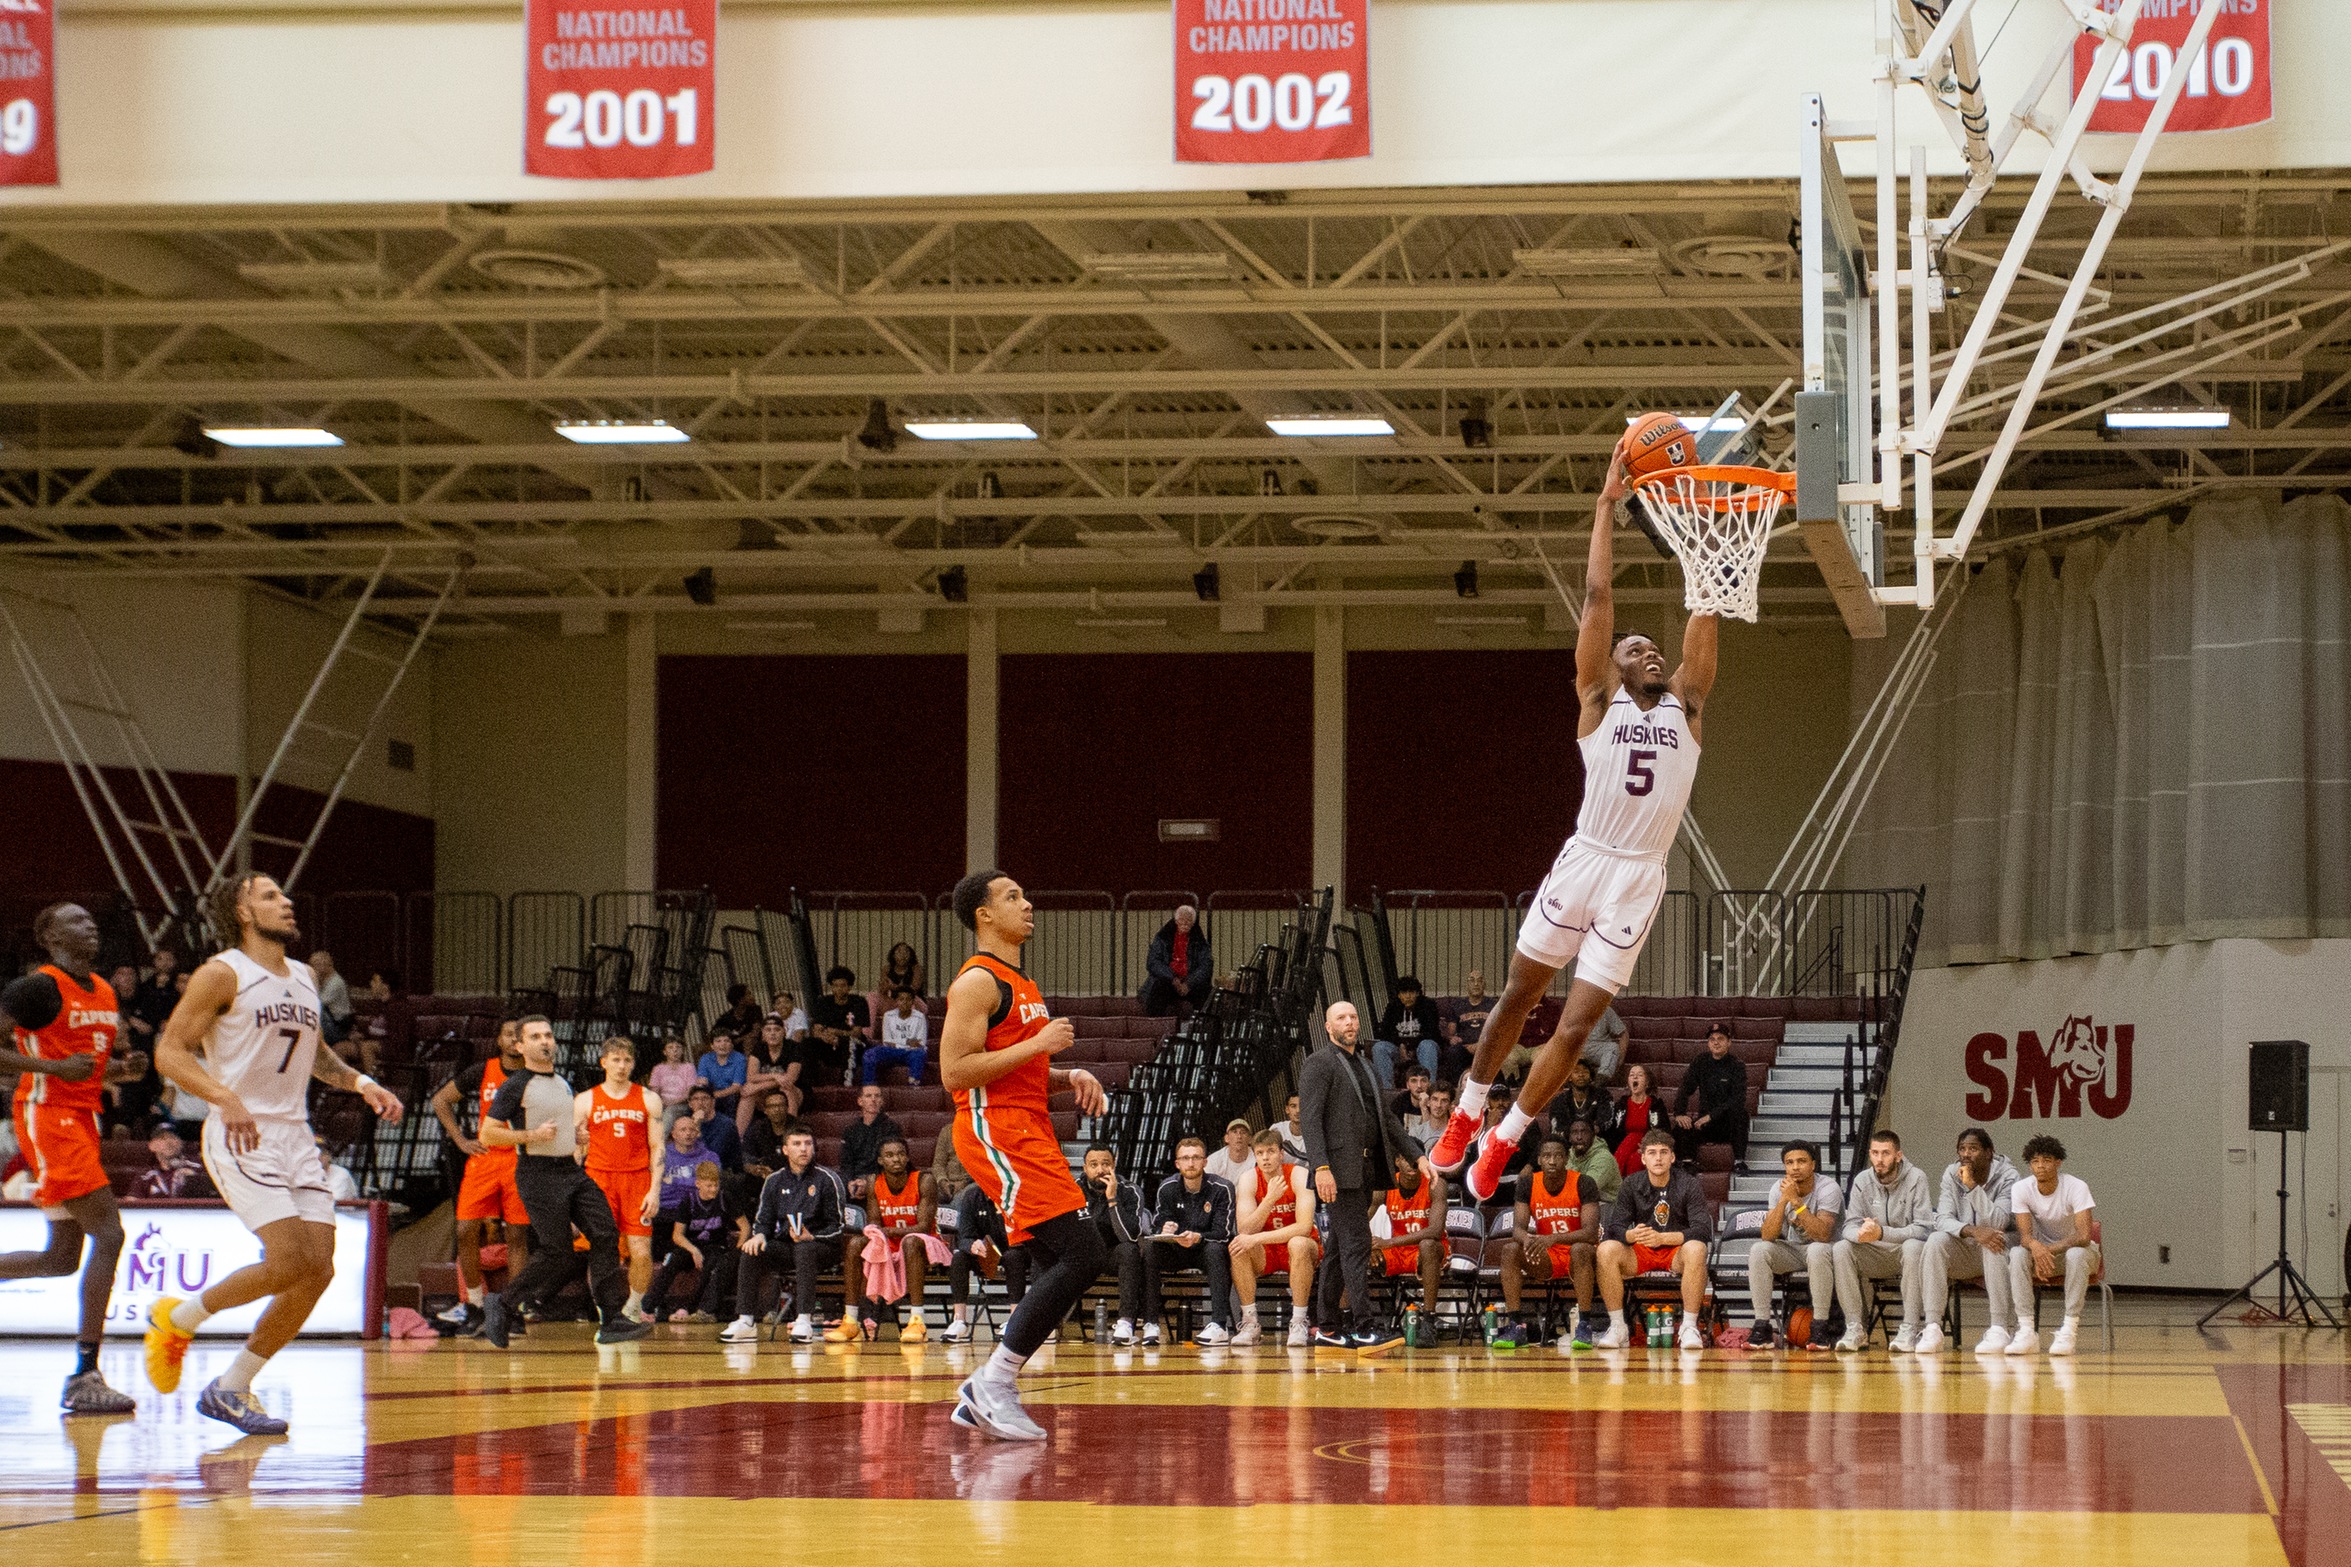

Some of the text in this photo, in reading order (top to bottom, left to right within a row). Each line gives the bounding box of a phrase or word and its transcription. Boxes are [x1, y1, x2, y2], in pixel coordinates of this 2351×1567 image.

[556, 10, 693, 38] NATIONAL
[1204, 0, 1343, 22] NATIONAL
[1189, 22, 1355, 53] CHAMPIONS
[541, 40, 707, 71] CHAMPIONS
[1191, 71, 1351, 131] 2002
[544, 88, 697, 148] 2001
[1611, 723, 1679, 750] HUSKIES
[1624, 748, 1657, 797] 5
[256, 1003, 318, 1031] HUSKIES
[277, 1027, 302, 1074] 7
[1965, 1023, 2135, 1122] SMU
[593, 1108, 644, 1125] CAPERS
[613, 1121, 627, 1138] 5
[1535, 1207, 1579, 1220] CAPERS
[1550, 1219, 1570, 1235] 13
